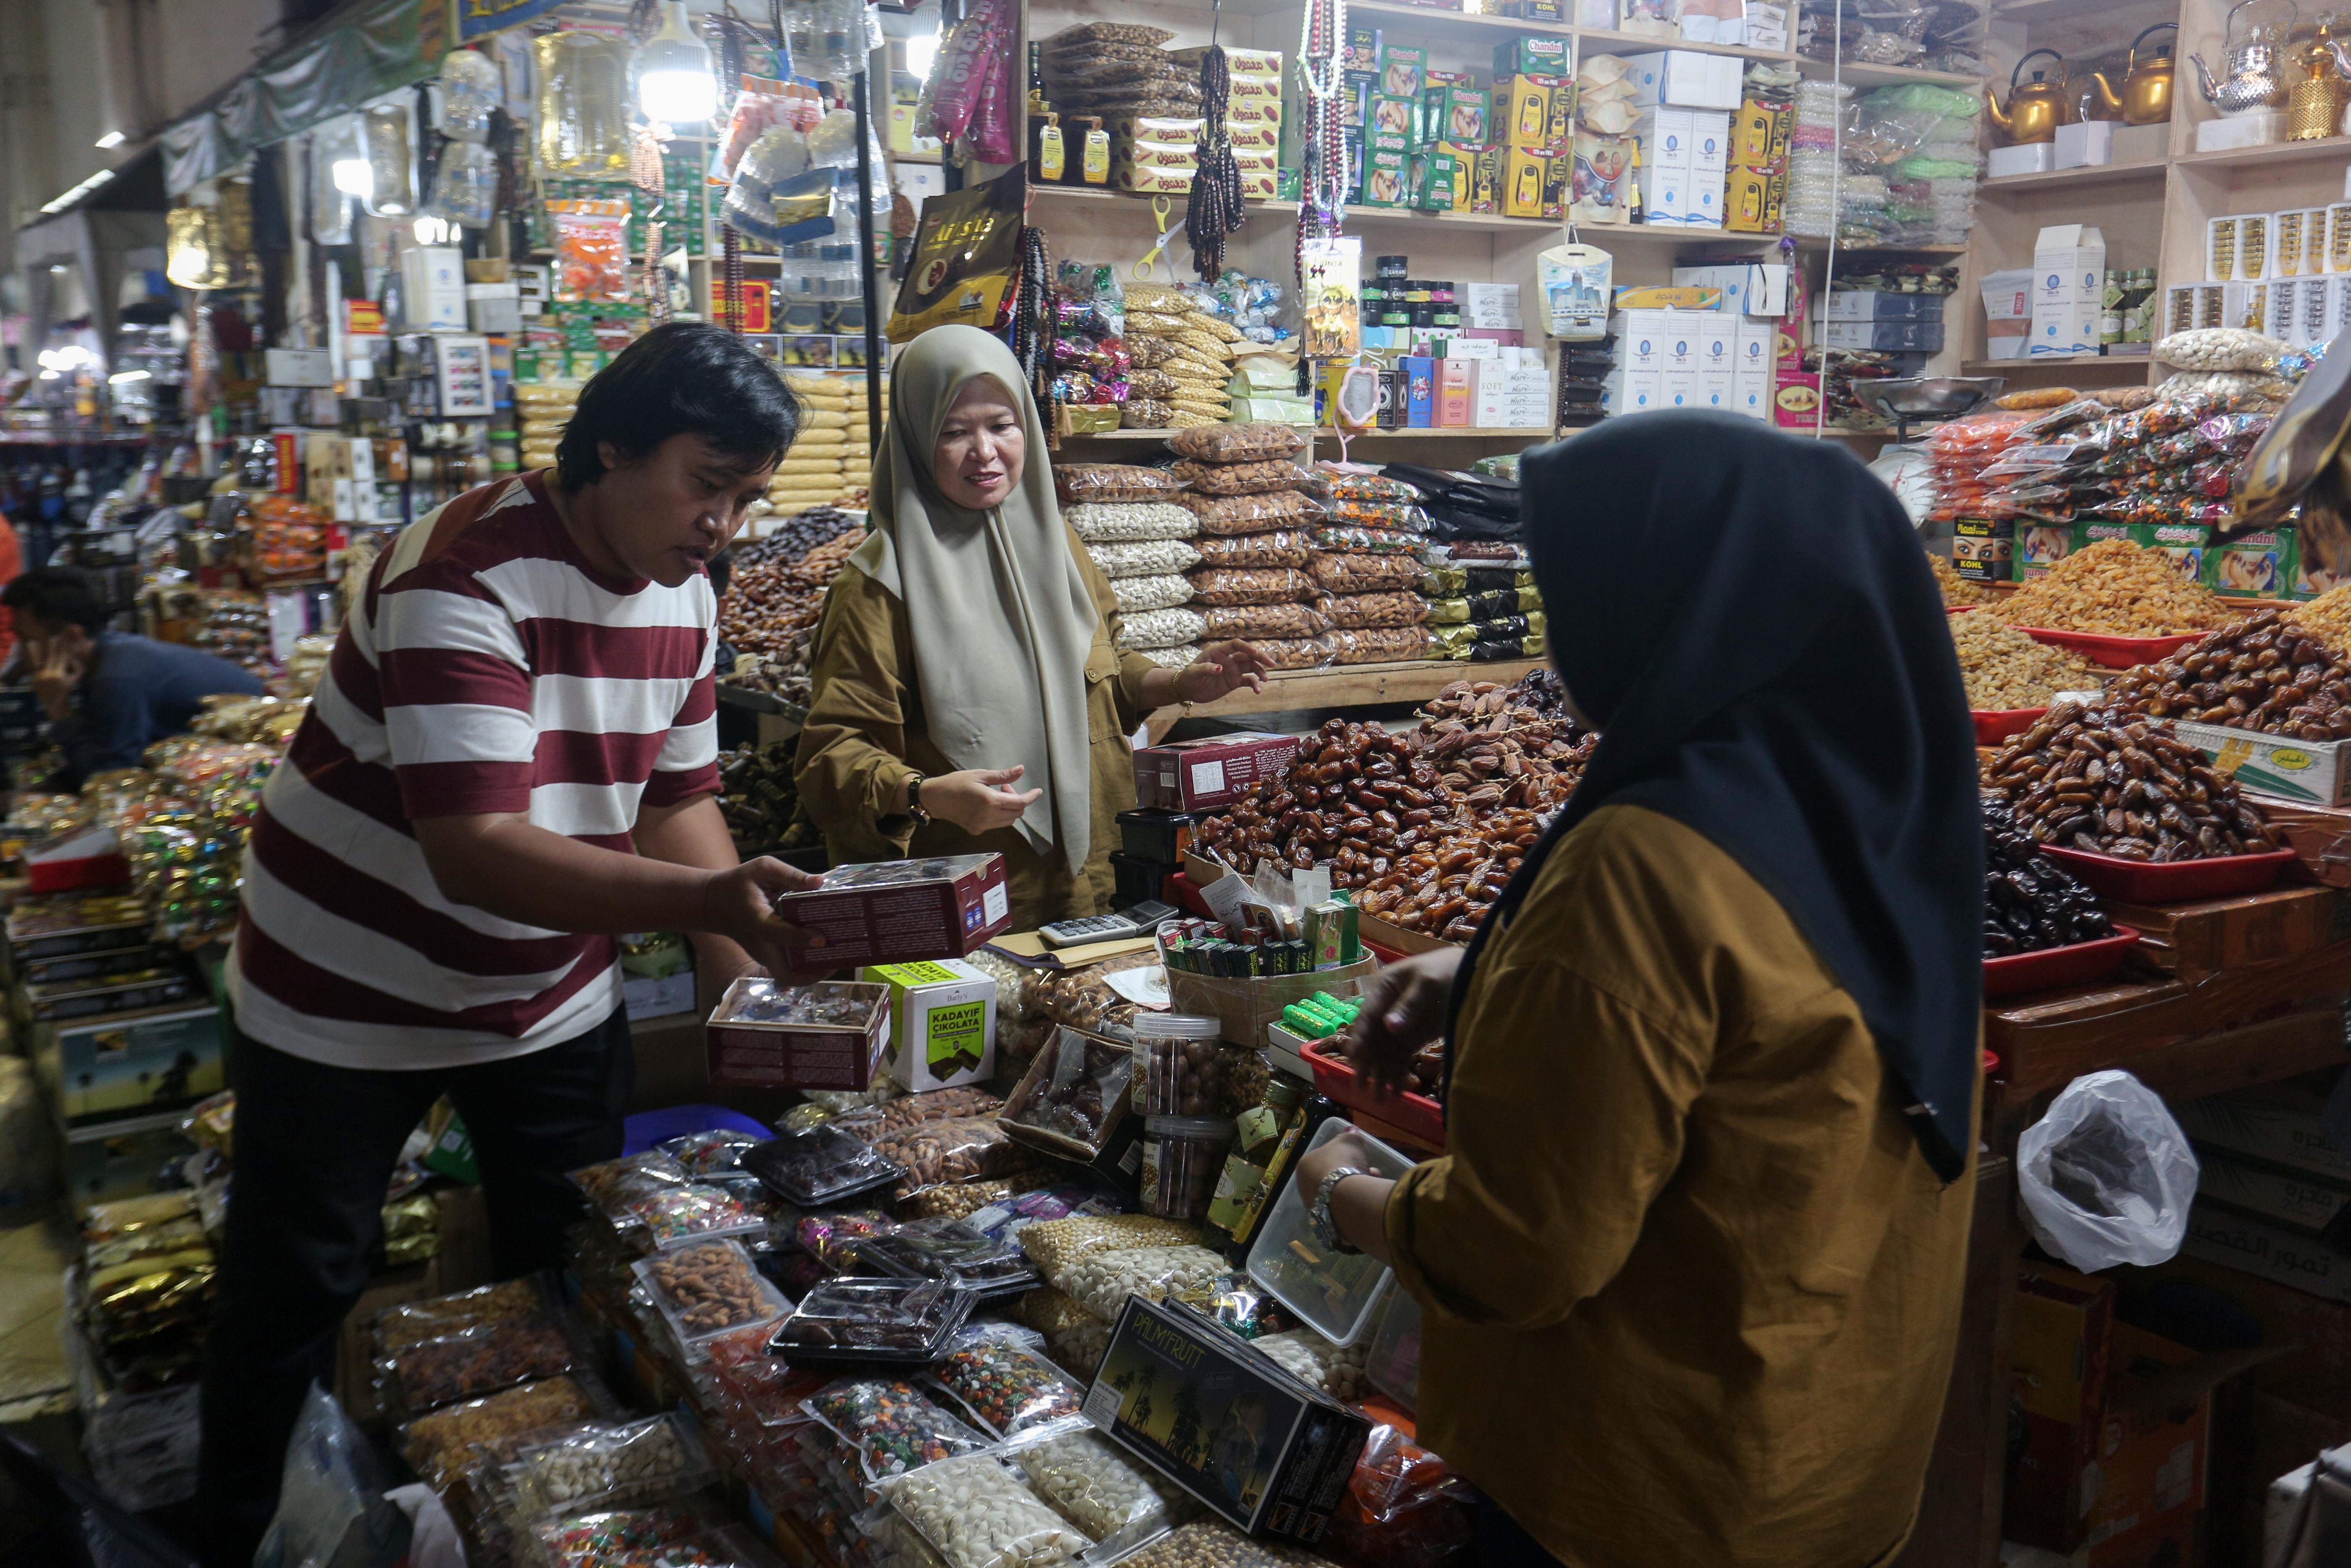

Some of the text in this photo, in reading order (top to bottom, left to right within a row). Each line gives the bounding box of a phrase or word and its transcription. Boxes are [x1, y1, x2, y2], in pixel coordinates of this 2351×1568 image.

[1530, 41, 1562, 52] Chandni
[1389, 48, 1419, 61] Chandni
[1453, 90, 1482, 103] Chandni
[1958, 524, 1976, 533] Rani
[1960, 560, 1983, 568] KOHL
[947, 993, 969, 1002] Barly's
[932, 1008, 980, 1023] KADAYIF
[932, 1018, 979, 1034] ÇIKOLATA
